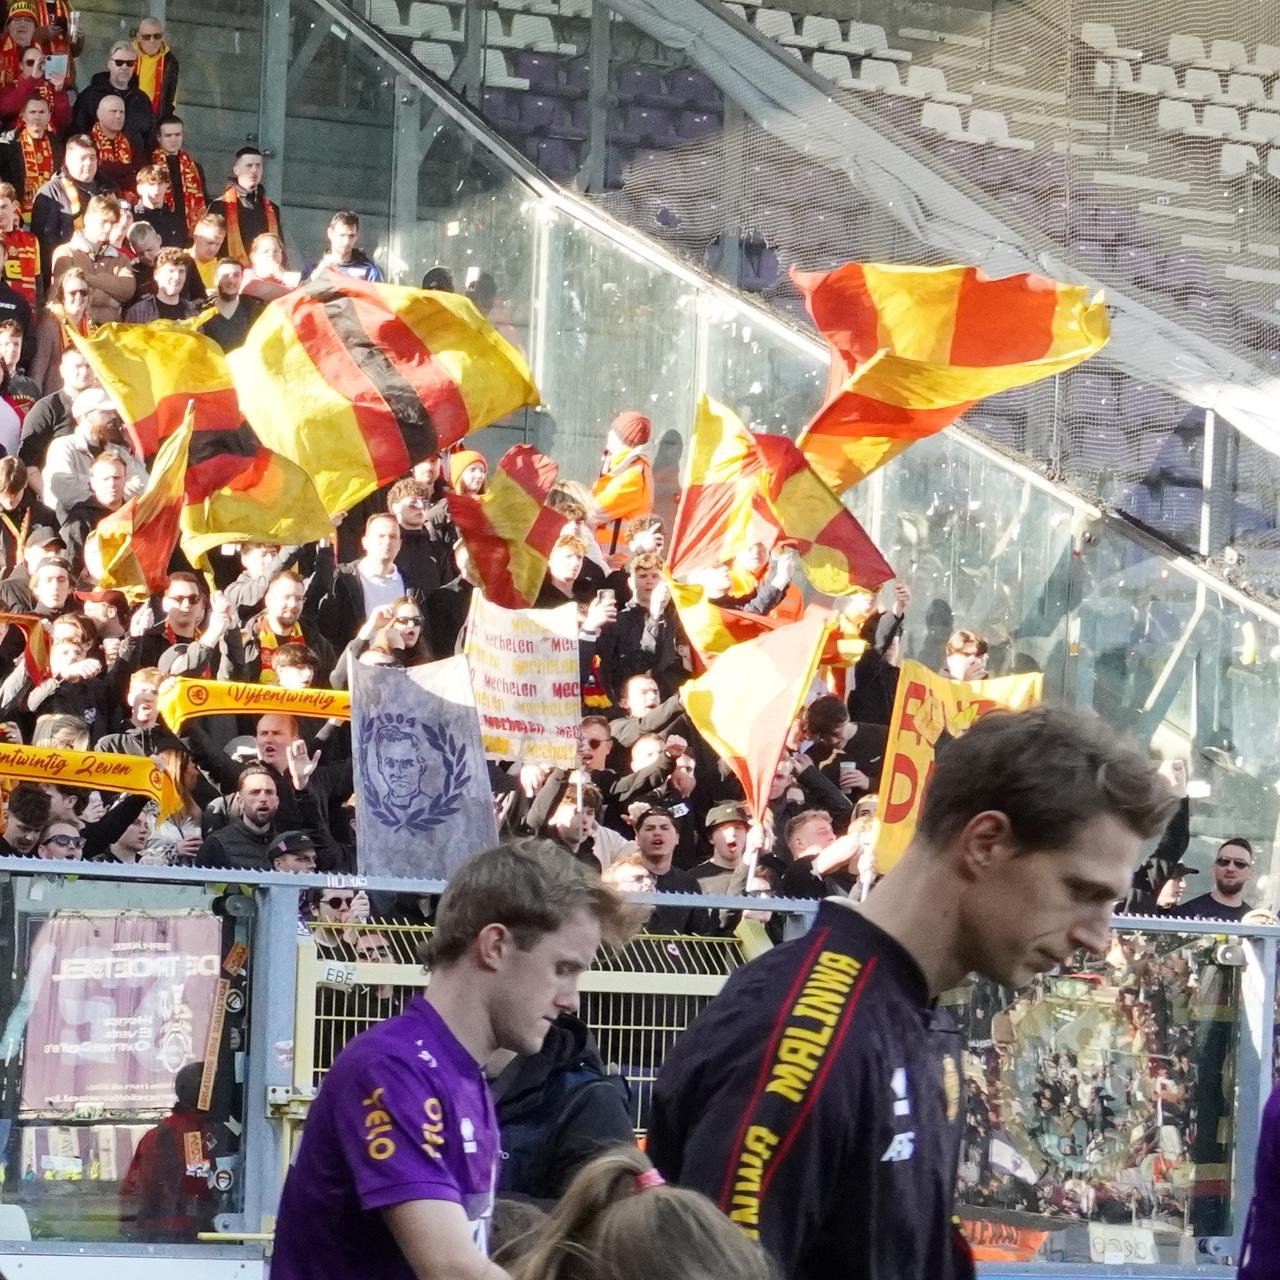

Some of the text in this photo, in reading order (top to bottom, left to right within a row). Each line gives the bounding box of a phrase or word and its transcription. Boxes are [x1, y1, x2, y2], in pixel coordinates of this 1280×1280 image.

[377, 710, 417, 729] 1904
[765, 950, 863, 1103] MALINWA
[362, 1086, 397, 1160] YELO
[729, 1125, 780, 1241] INWA
